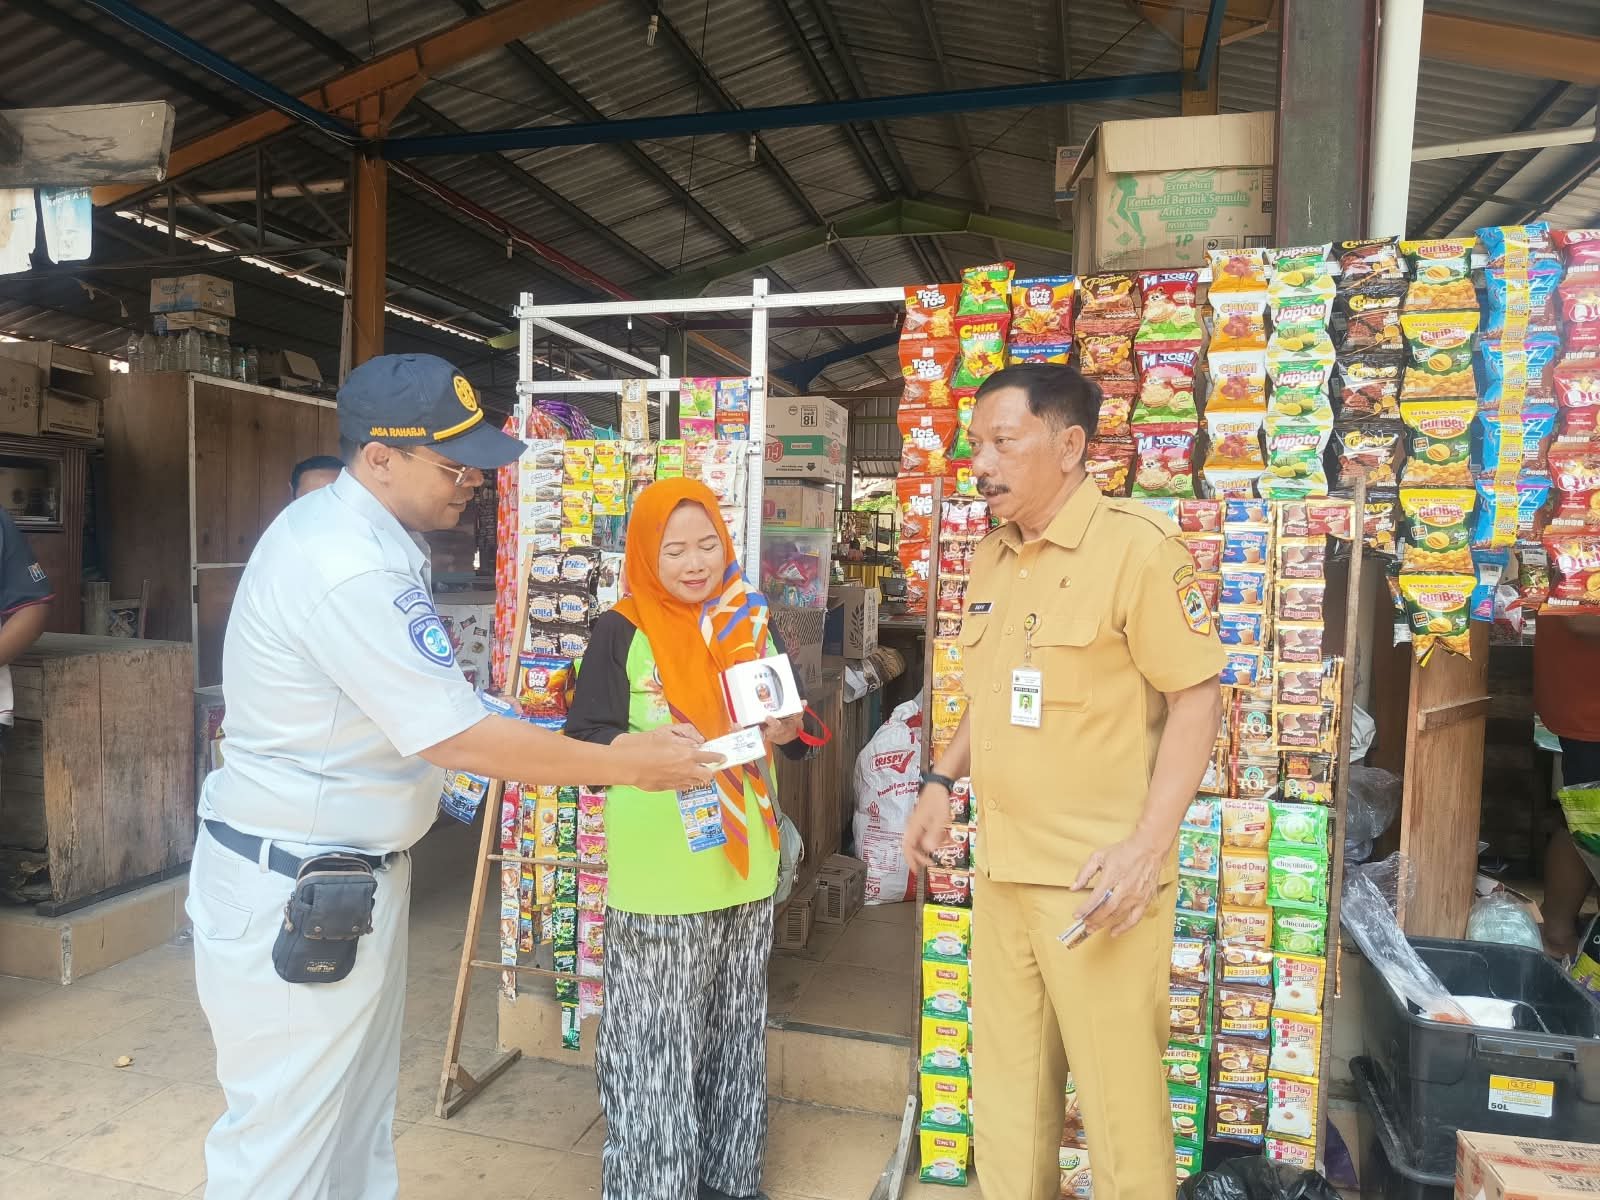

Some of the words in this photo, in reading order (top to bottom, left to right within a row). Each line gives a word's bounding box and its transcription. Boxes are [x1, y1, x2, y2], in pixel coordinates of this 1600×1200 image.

[803, 415, 815, 426] 18
[370, 427, 389, 437] JASA
[389, 426, 427, 438] RAHARJA
[875, 753, 904, 767] CRISPY
[1225, 861, 1247, 870] Good
[1248, 862, 1266, 872] Day
[1226, 915, 1247, 923] Good
[1248, 916, 1265, 926] Day
[1227, 968, 1268, 977] ENERGEN
[1277, 960, 1299, 970] Good
[1300, 964, 1318, 974] Day
[1223, 1021, 1264, 1029] ENERGEN
[1273, 1021, 1295, 1031] Good
[1296, 1024, 1314, 1035] Day
[1165, 1050, 1198, 1059] NERGEN
[1222, 1073, 1263, 1082] ENERGEN
[1270, 1082, 1292, 1092] Good
[1293, 1084, 1311, 1096] Day
[1491, 1102, 1509, 1110] 50L
[1218, 1125, 1260, 1135] ENERGEN
[1267, 1142, 1289, 1152] Good
[1290, 1146, 1307, 1158] Day
